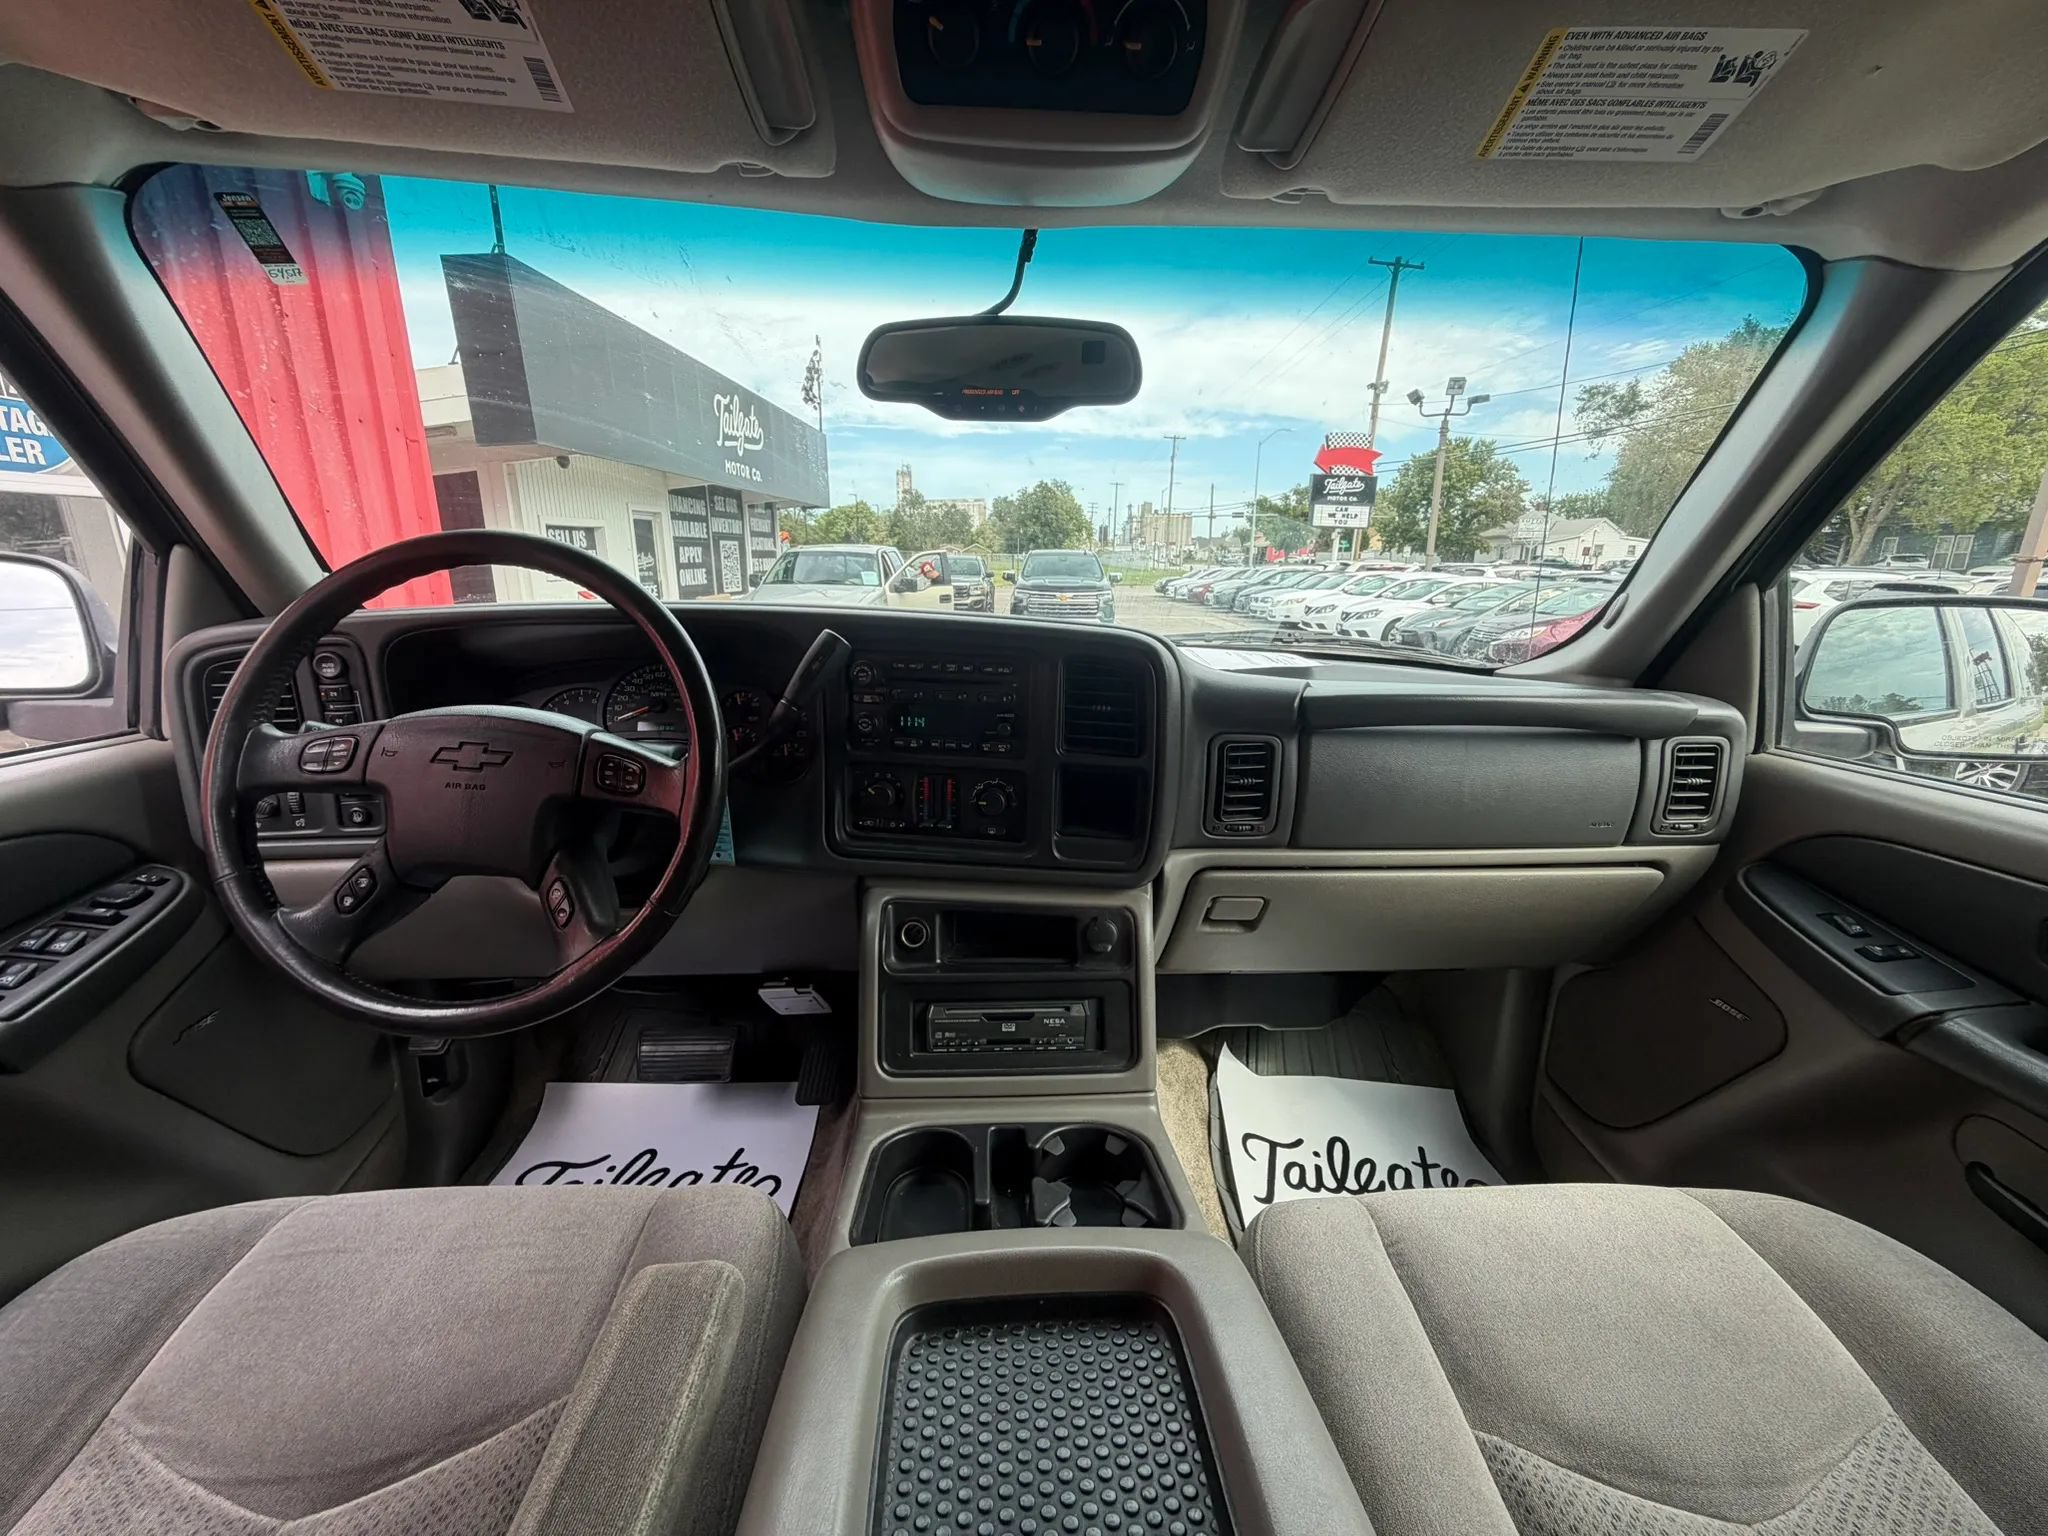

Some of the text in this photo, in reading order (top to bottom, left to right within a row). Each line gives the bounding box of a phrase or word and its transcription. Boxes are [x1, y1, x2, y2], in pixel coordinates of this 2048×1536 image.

[1590, 31, 1613, 41] WITH
[1613, 31, 1664, 41] ADVANCED
[0, 405, 55, 437] TAG
[713, 393, 765, 457] Tailgate
[724, 459, 751, 479] MOTOR
[1323, 476, 1365, 495] Tailgate
[672, 519, 709, 539] VAILABLE
[679, 545, 703, 564] APPLY
[679, 567, 708, 587] ONLINE
[444, 781, 486, 791] AIR BAG
